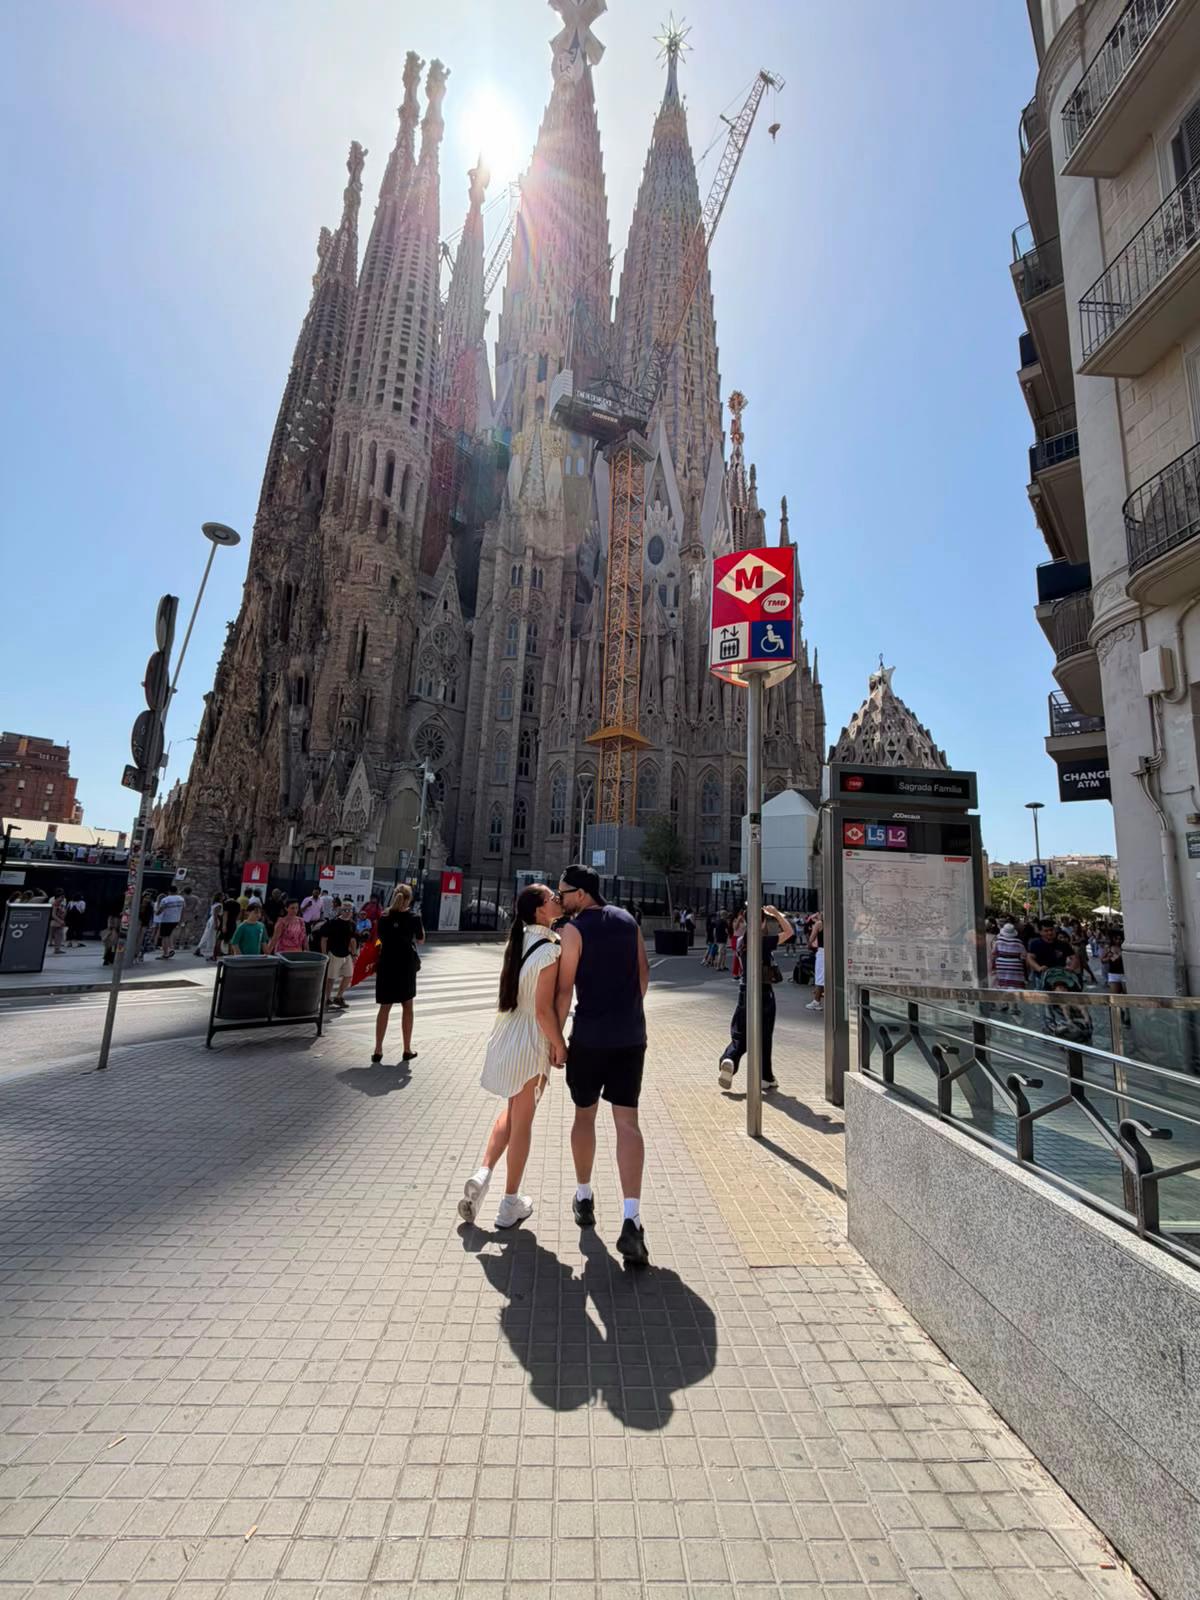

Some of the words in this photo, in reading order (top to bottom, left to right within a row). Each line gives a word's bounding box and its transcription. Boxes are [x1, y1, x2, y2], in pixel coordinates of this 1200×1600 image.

[735, 565, 764, 592] M
[767, 599, 787, 607] TMB
[1063, 770, 1112, 781] CHANGE
[899, 782, 932, 793] Sagrada
[1077, 780, 1100, 789] ATM
[868, 827, 885, 840] L5
[888, 830, 906, 842] L2
[1033, 866, 1044, 879] P
